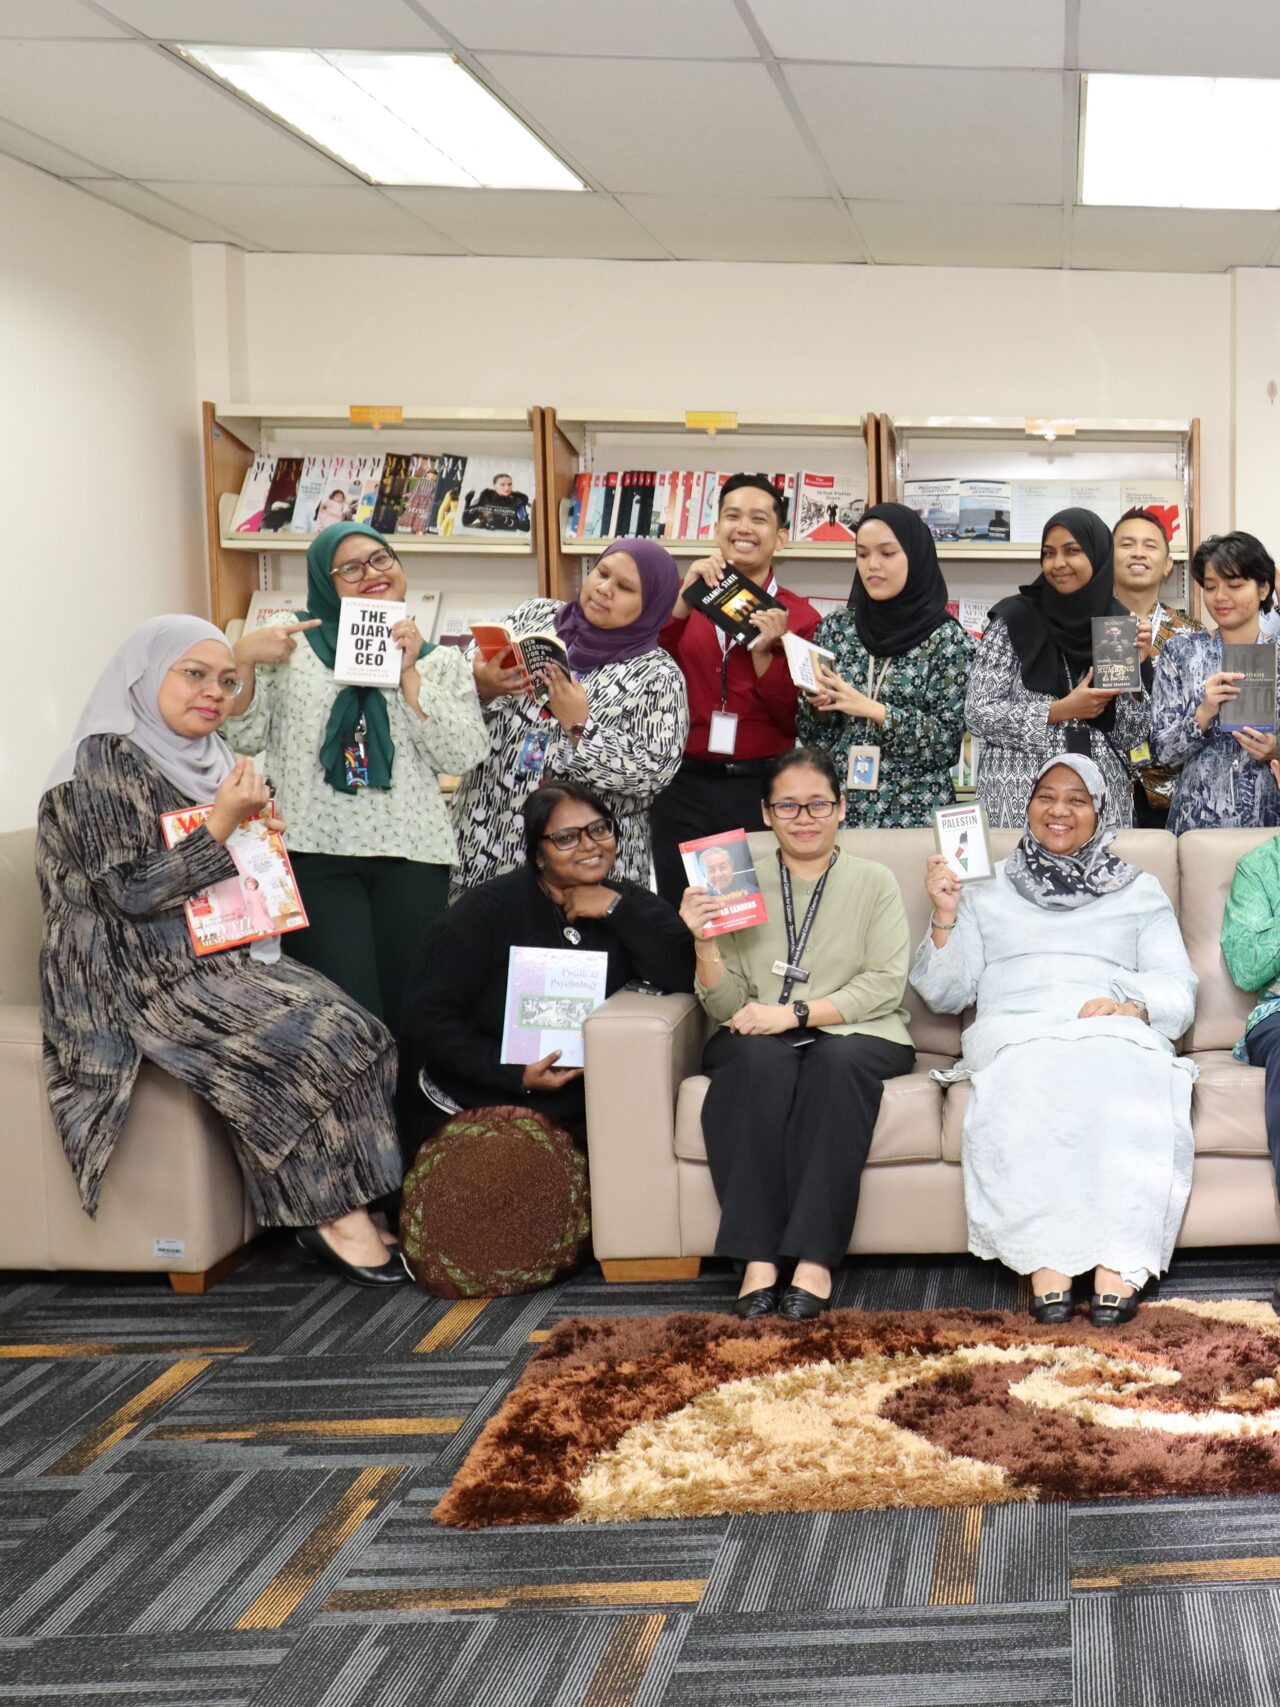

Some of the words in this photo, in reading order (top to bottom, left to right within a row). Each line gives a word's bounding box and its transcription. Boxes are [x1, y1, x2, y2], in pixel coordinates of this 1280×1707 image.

[701, 586, 724, 604] ISLAMIC
[721, 573, 739, 589] STATE
[360, 610, 387, 624] THE
[350, 623, 393, 638] DIARY
[355, 638, 373, 651] OF
[378, 640, 387, 652] A
[524, 639, 536, 647] TEN
[525, 644, 553, 653] LESSONS
[355, 652, 384, 666] CEO
[526, 650, 540, 659] FOR
[942, 814, 978, 830] PALESTIN
[730, 901, 757, 913] LEADERS
[562, 968, 599, 978] Political
[550, 979, 597, 990] Psychology
